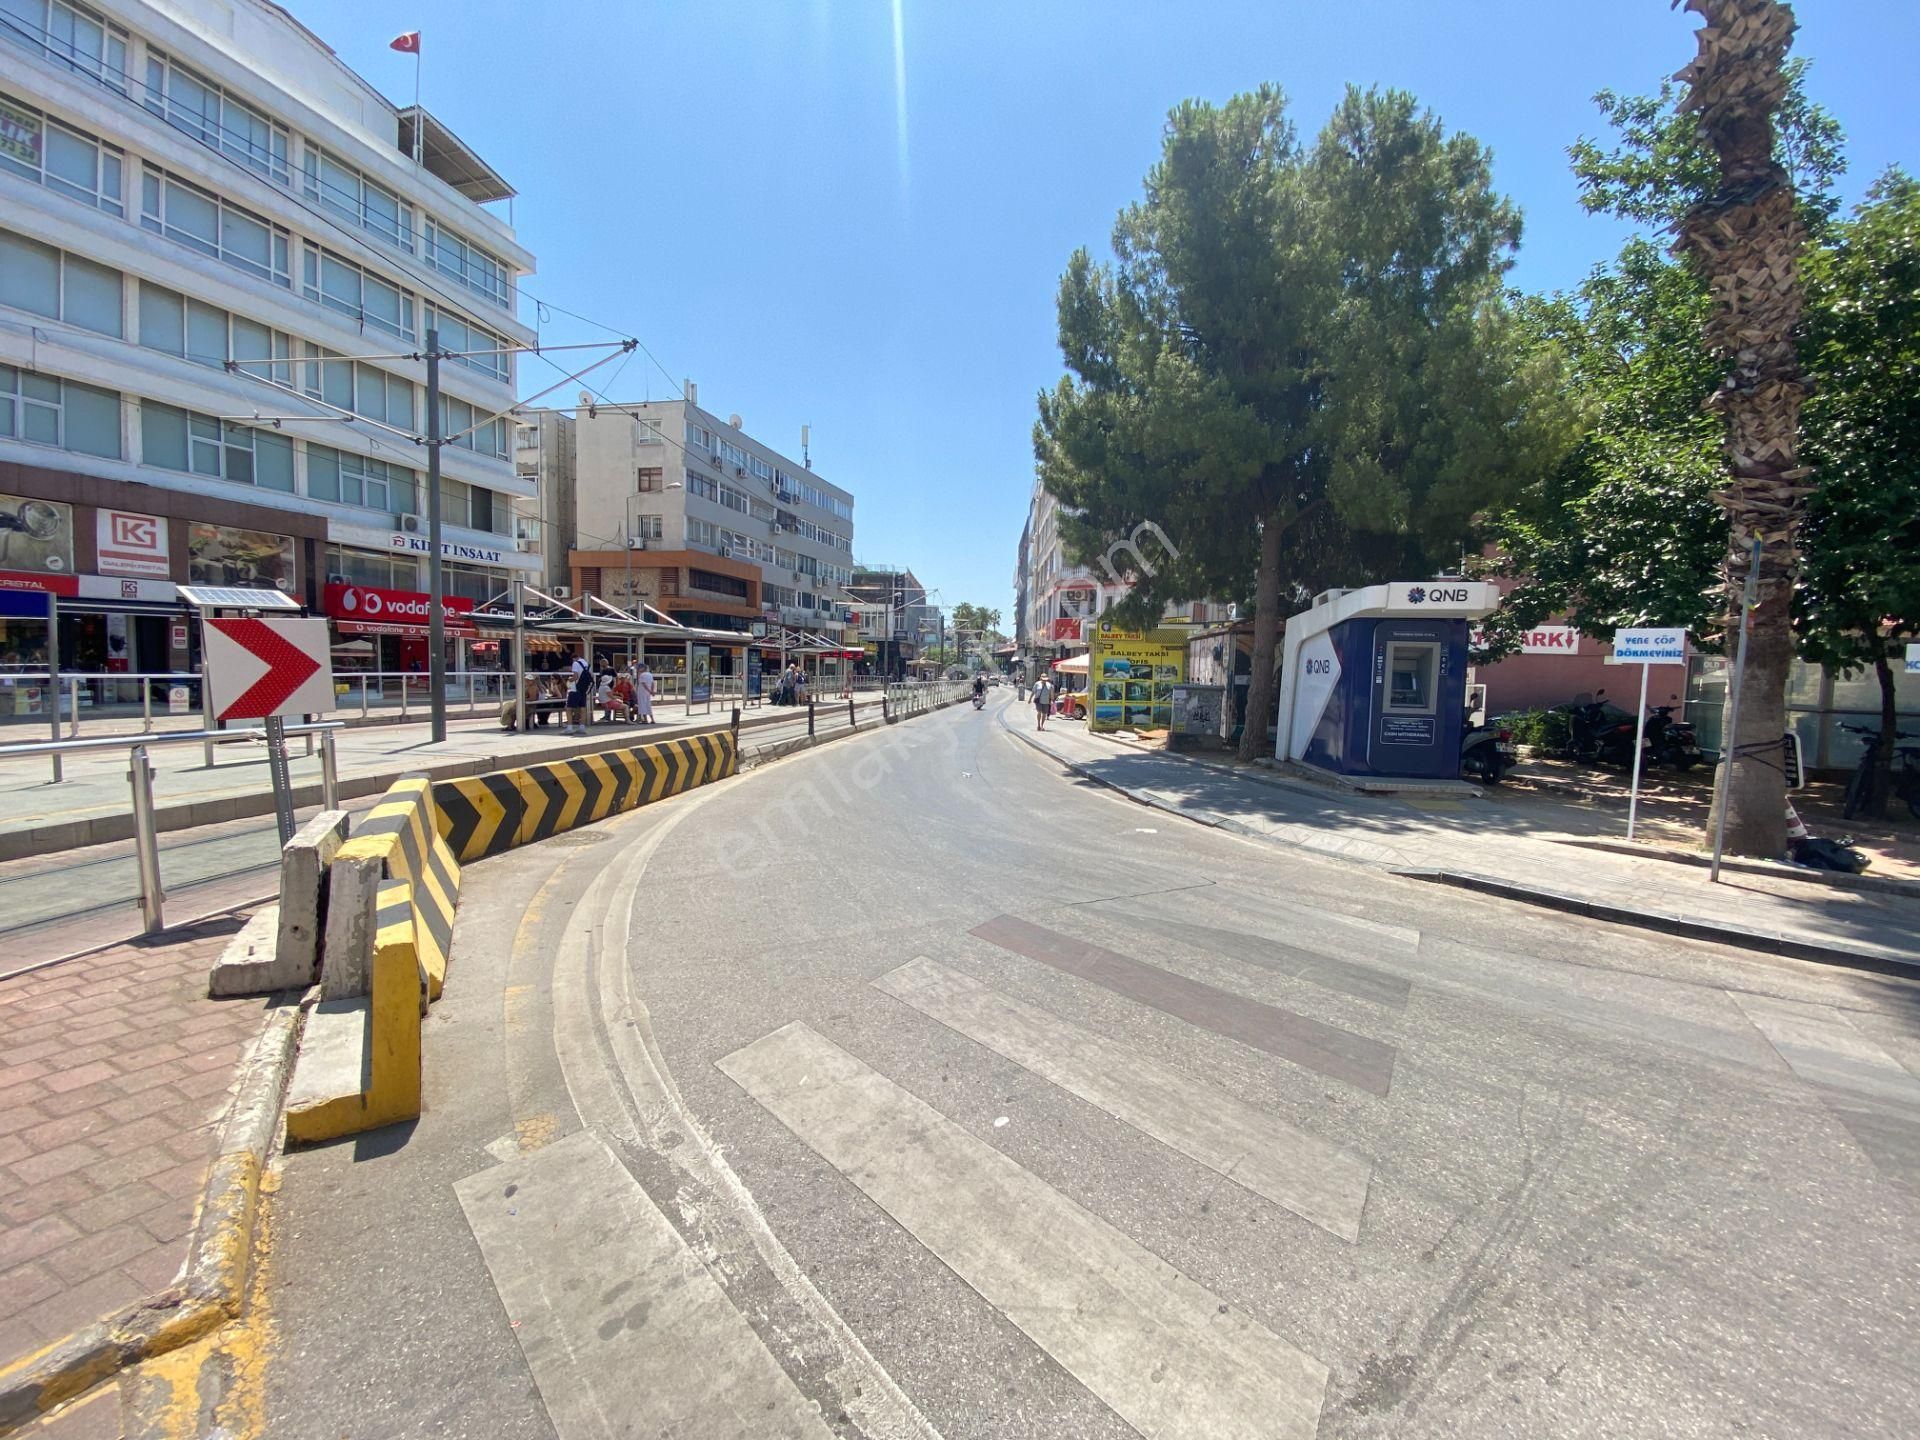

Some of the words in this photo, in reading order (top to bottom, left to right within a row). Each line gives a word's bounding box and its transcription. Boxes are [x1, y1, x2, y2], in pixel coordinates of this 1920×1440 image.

[1429, 588, 1468, 602] QNB
[366, 625, 404, 634] vodafone
[1654, 634, 1676, 646] ÇÖP
[1313, 659, 1330, 674] QNB
